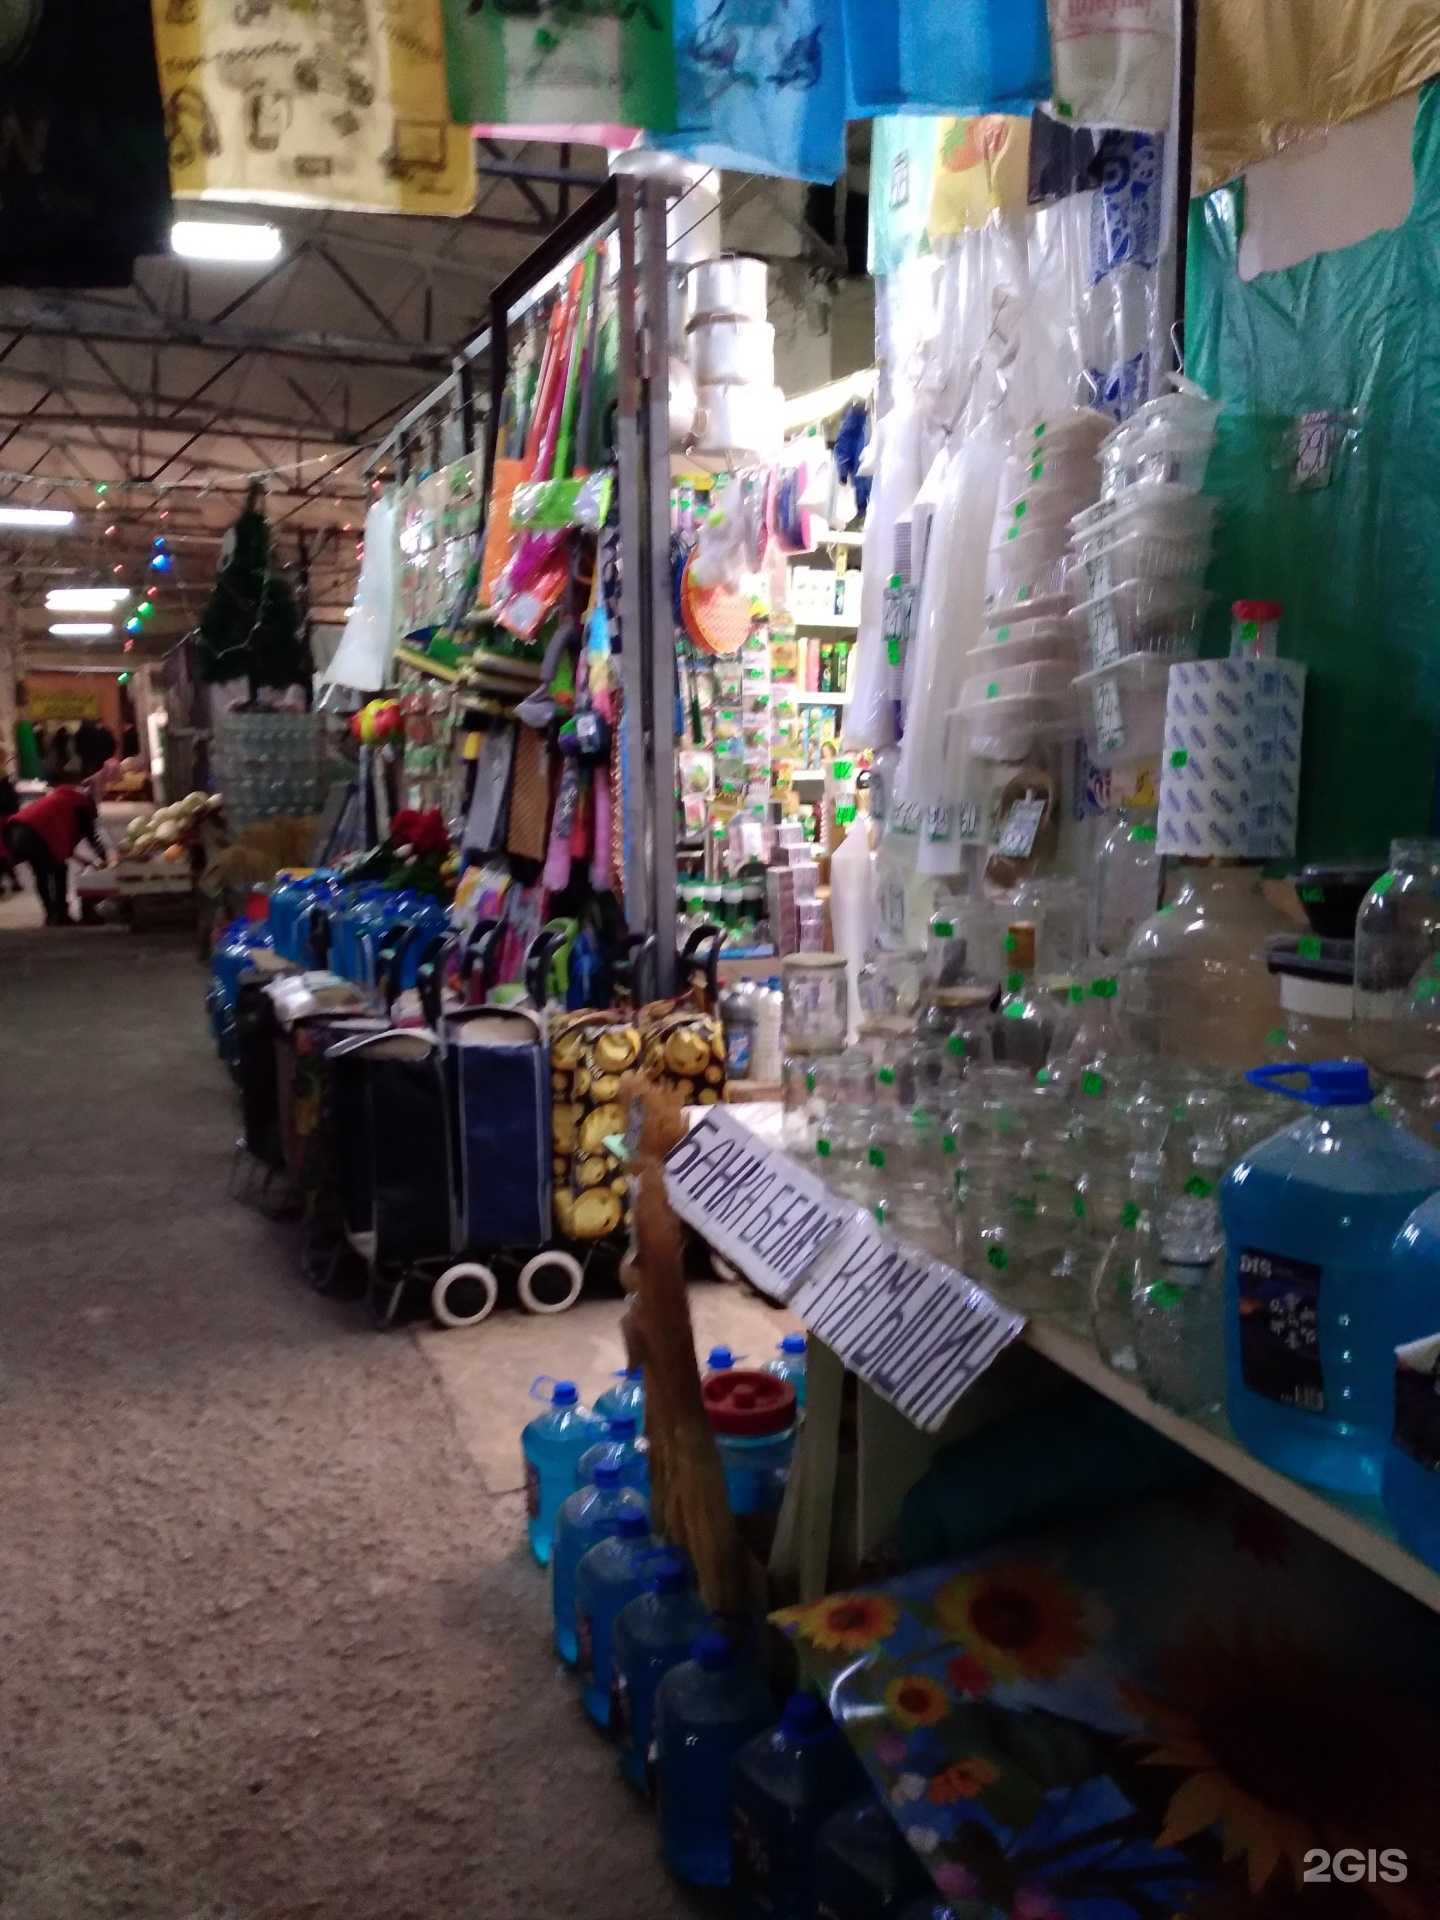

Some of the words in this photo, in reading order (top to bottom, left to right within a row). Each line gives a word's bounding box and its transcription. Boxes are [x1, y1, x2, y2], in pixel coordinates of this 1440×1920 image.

[665, 1118, 777, 1232] БАНКА
[738, 1185, 845, 1279] БЕЛАЯ
[802, 1235, 1020, 1426] КАМЫШИН
